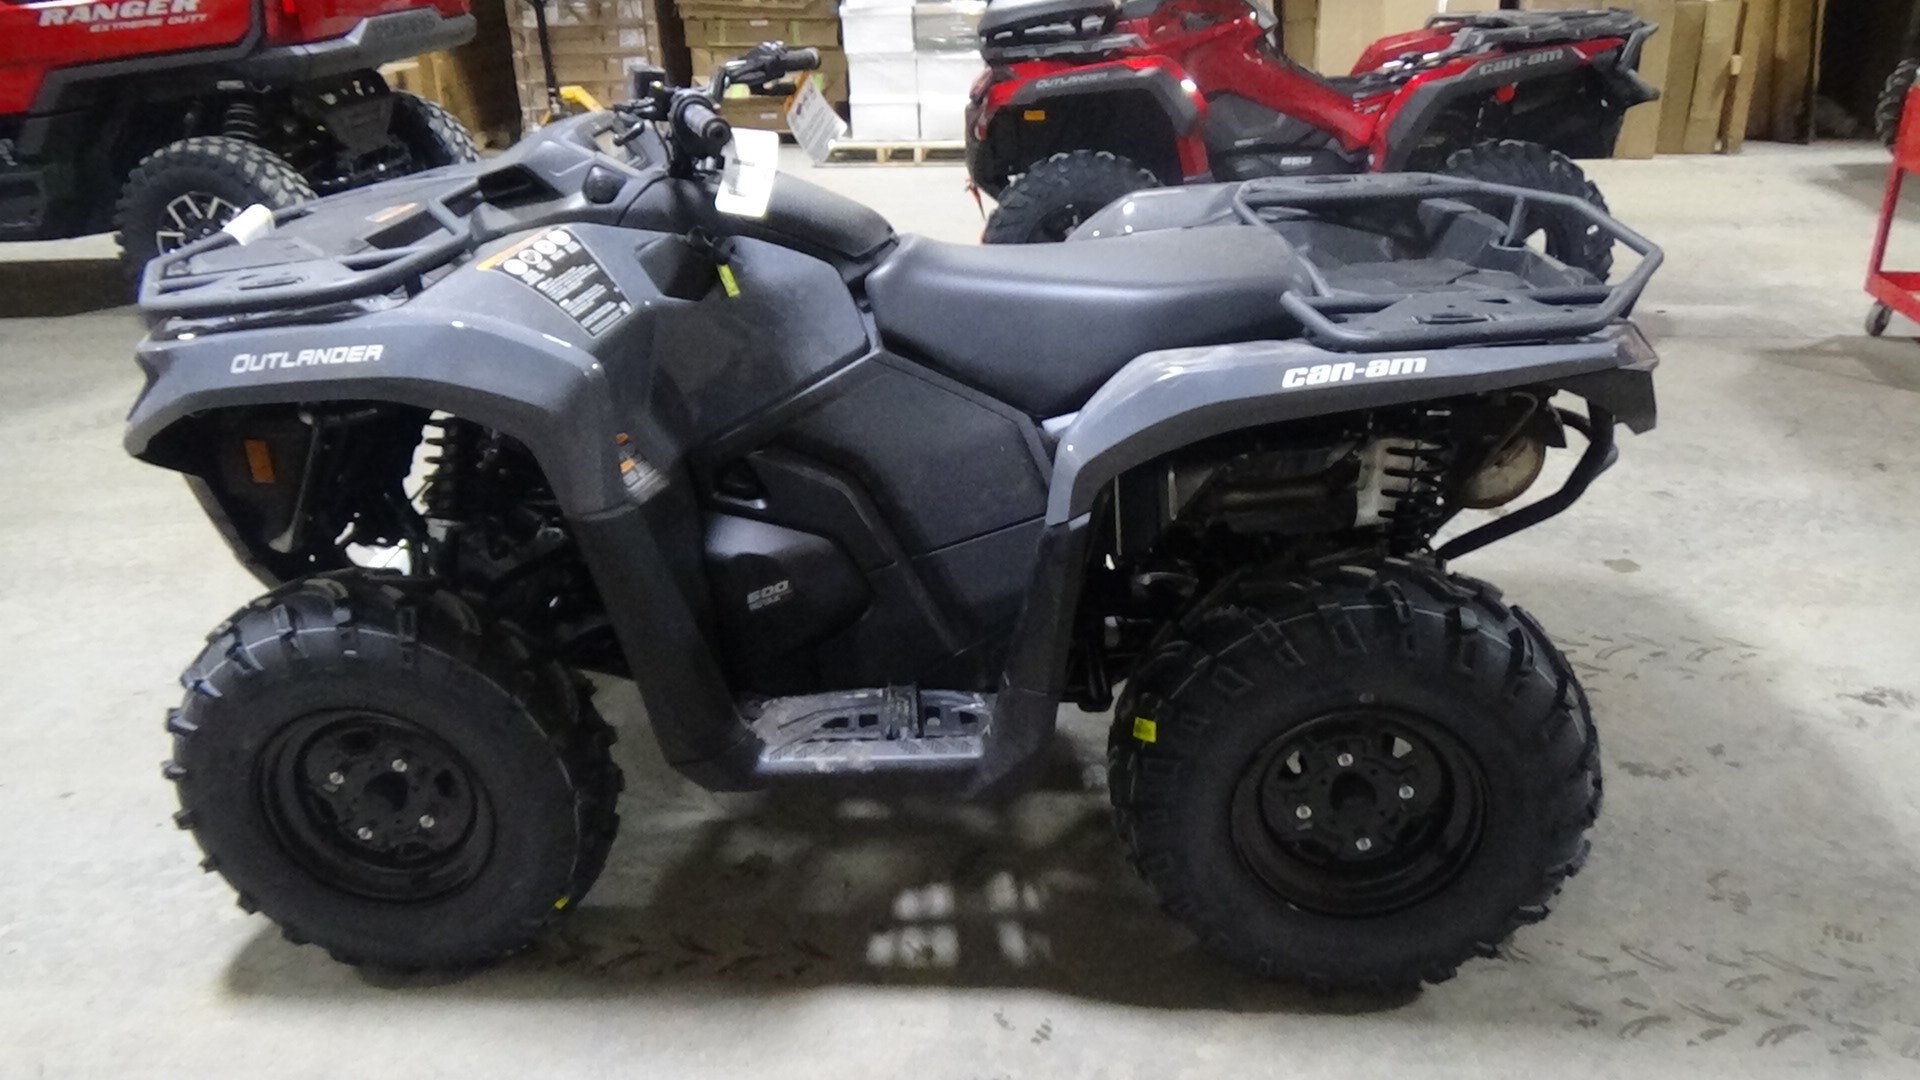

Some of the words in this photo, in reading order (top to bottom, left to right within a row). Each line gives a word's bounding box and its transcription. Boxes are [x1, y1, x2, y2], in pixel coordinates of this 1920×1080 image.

[38, 0, 200, 27] RANGER
[1478, 48, 1563, 76] can-am
[230, 344, 384, 374] OUTLANDER
[1281, 357, 1427, 388] can-am
